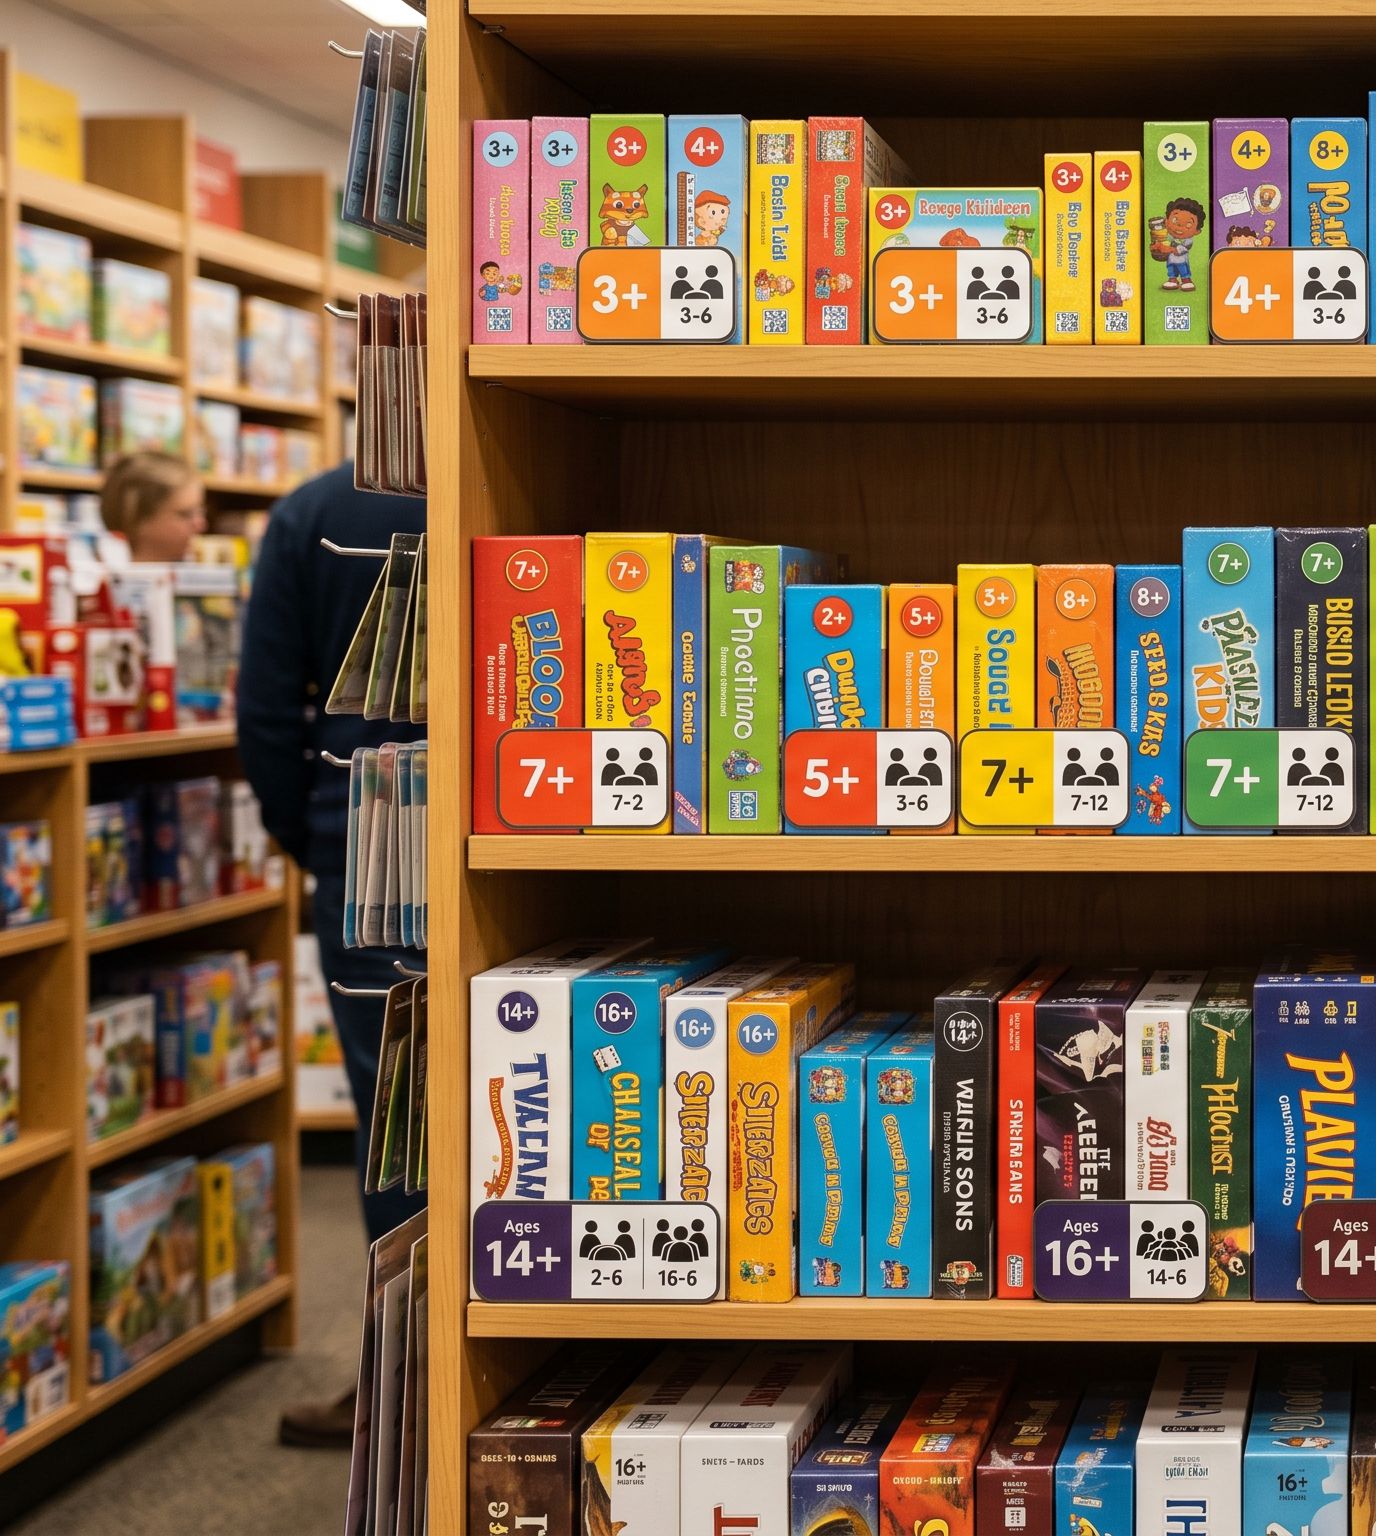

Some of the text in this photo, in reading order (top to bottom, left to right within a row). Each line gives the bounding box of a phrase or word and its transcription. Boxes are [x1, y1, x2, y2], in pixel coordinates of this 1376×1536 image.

[489, 140, 514, 157] 3+
[548, 139, 573, 157] 3+
[613, 137, 641, 157] 3+
[691, 137, 719, 156] 4+
[1163, 142, 1192, 162] 3+
[1237, 140, 1265, 159] 4+
[1317, 140, 1343, 159] 8+
[1057, 169, 1080, 184] 3+
[1105, 168, 1128, 183] 4+
[881, 203, 906, 220] 3+
[592, 275, 648, 314] 3+
[889, 275, 943, 314] 3+
[1224, 275, 1280, 314] 4+
[680, 307, 712, 324] 3-6
[977, 308, 1008, 324] 3-6
[1313, 308, 1345, 324] 3-6
[515, 562, 540, 578] 7+
[616, 562, 640, 579] 7+
[1217, 555, 1242, 572] 7+
[1310, 554, 1335, 572] 7+
[1063, 591, 1089, 608] 8+
[1137, 588, 1163, 605] 8+
[822, 608, 846, 625] 2+
[910, 608, 935, 625] 5+
[519, 758, 573, 798] 7+
[803, 758, 859, 798] 5+
[982, 759, 1033, 797] 7+
[1206, 758, 1260, 797] 7+
[612, 794, 642, 811] 7-2
[896, 795, 928, 811] 3-6
[1071, 794, 1108, 811] 7-12
[1297, 795, 1333, 811] 7-12
[501, 1002, 534, 1021] 14+
[599, 1003, 633, 1022] 16+
[679, 1019, 711, 1038] 16+
[743, 1025, 774, 1044] 16+
[956, 1167, 974, 1231] SONS
[504, 1220, 540, 1239] Ages
[1063, 1221, 1099, 1239] Ages
[1333, 1219, 1368, 1237] Ages
[486, 1241, 561, 1277] 14+
[1045, 1240, 1120, 1276] 16+
[591, 1270, 622, 1285] 2-6
[658, 1270, 697, 1286] 16-6
[1147, 1269, 1186, 1285] 14-6
[616, 1458, 646, 1476] 16+
[1278, 1473, 1308, 1491] 16+
